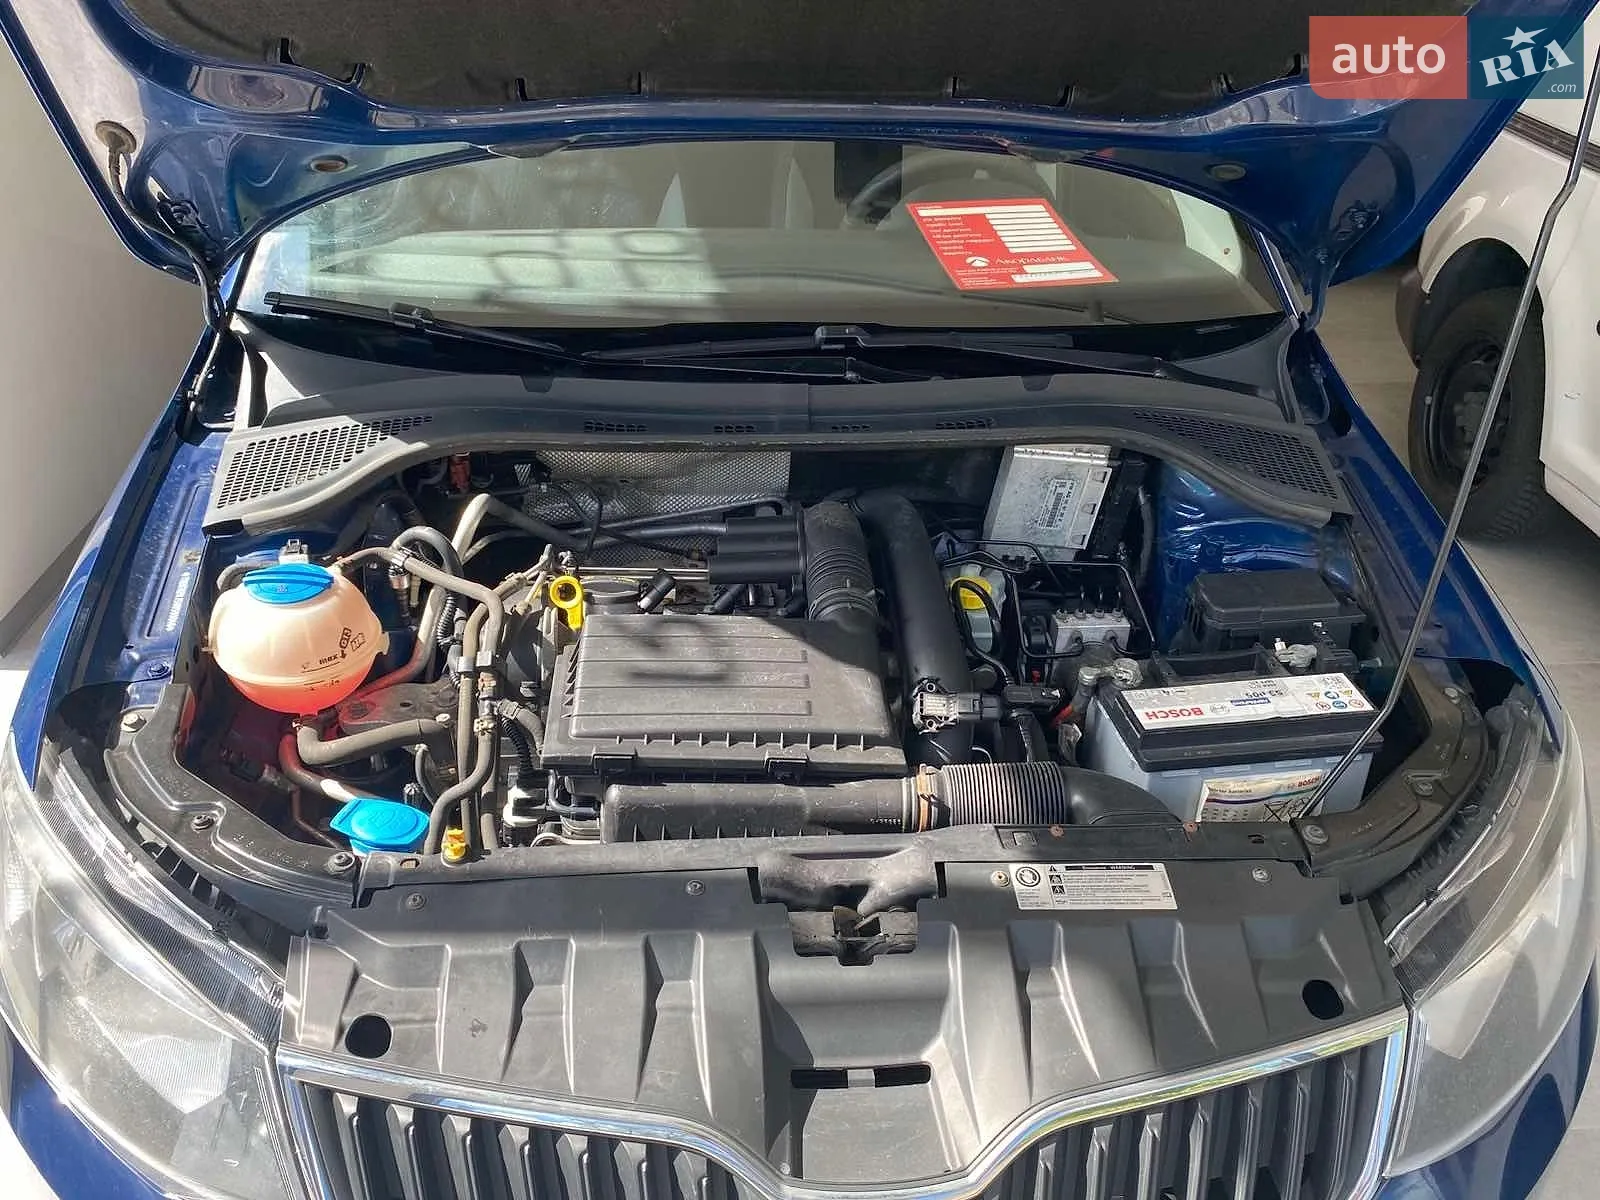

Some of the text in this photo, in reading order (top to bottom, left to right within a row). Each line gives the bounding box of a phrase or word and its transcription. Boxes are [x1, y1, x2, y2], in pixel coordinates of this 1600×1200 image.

[319, 654, 339, 664] max
[1145, 707, 1204, 720] BOSCH
[1297, 776, 1321, 788] BOSCH
